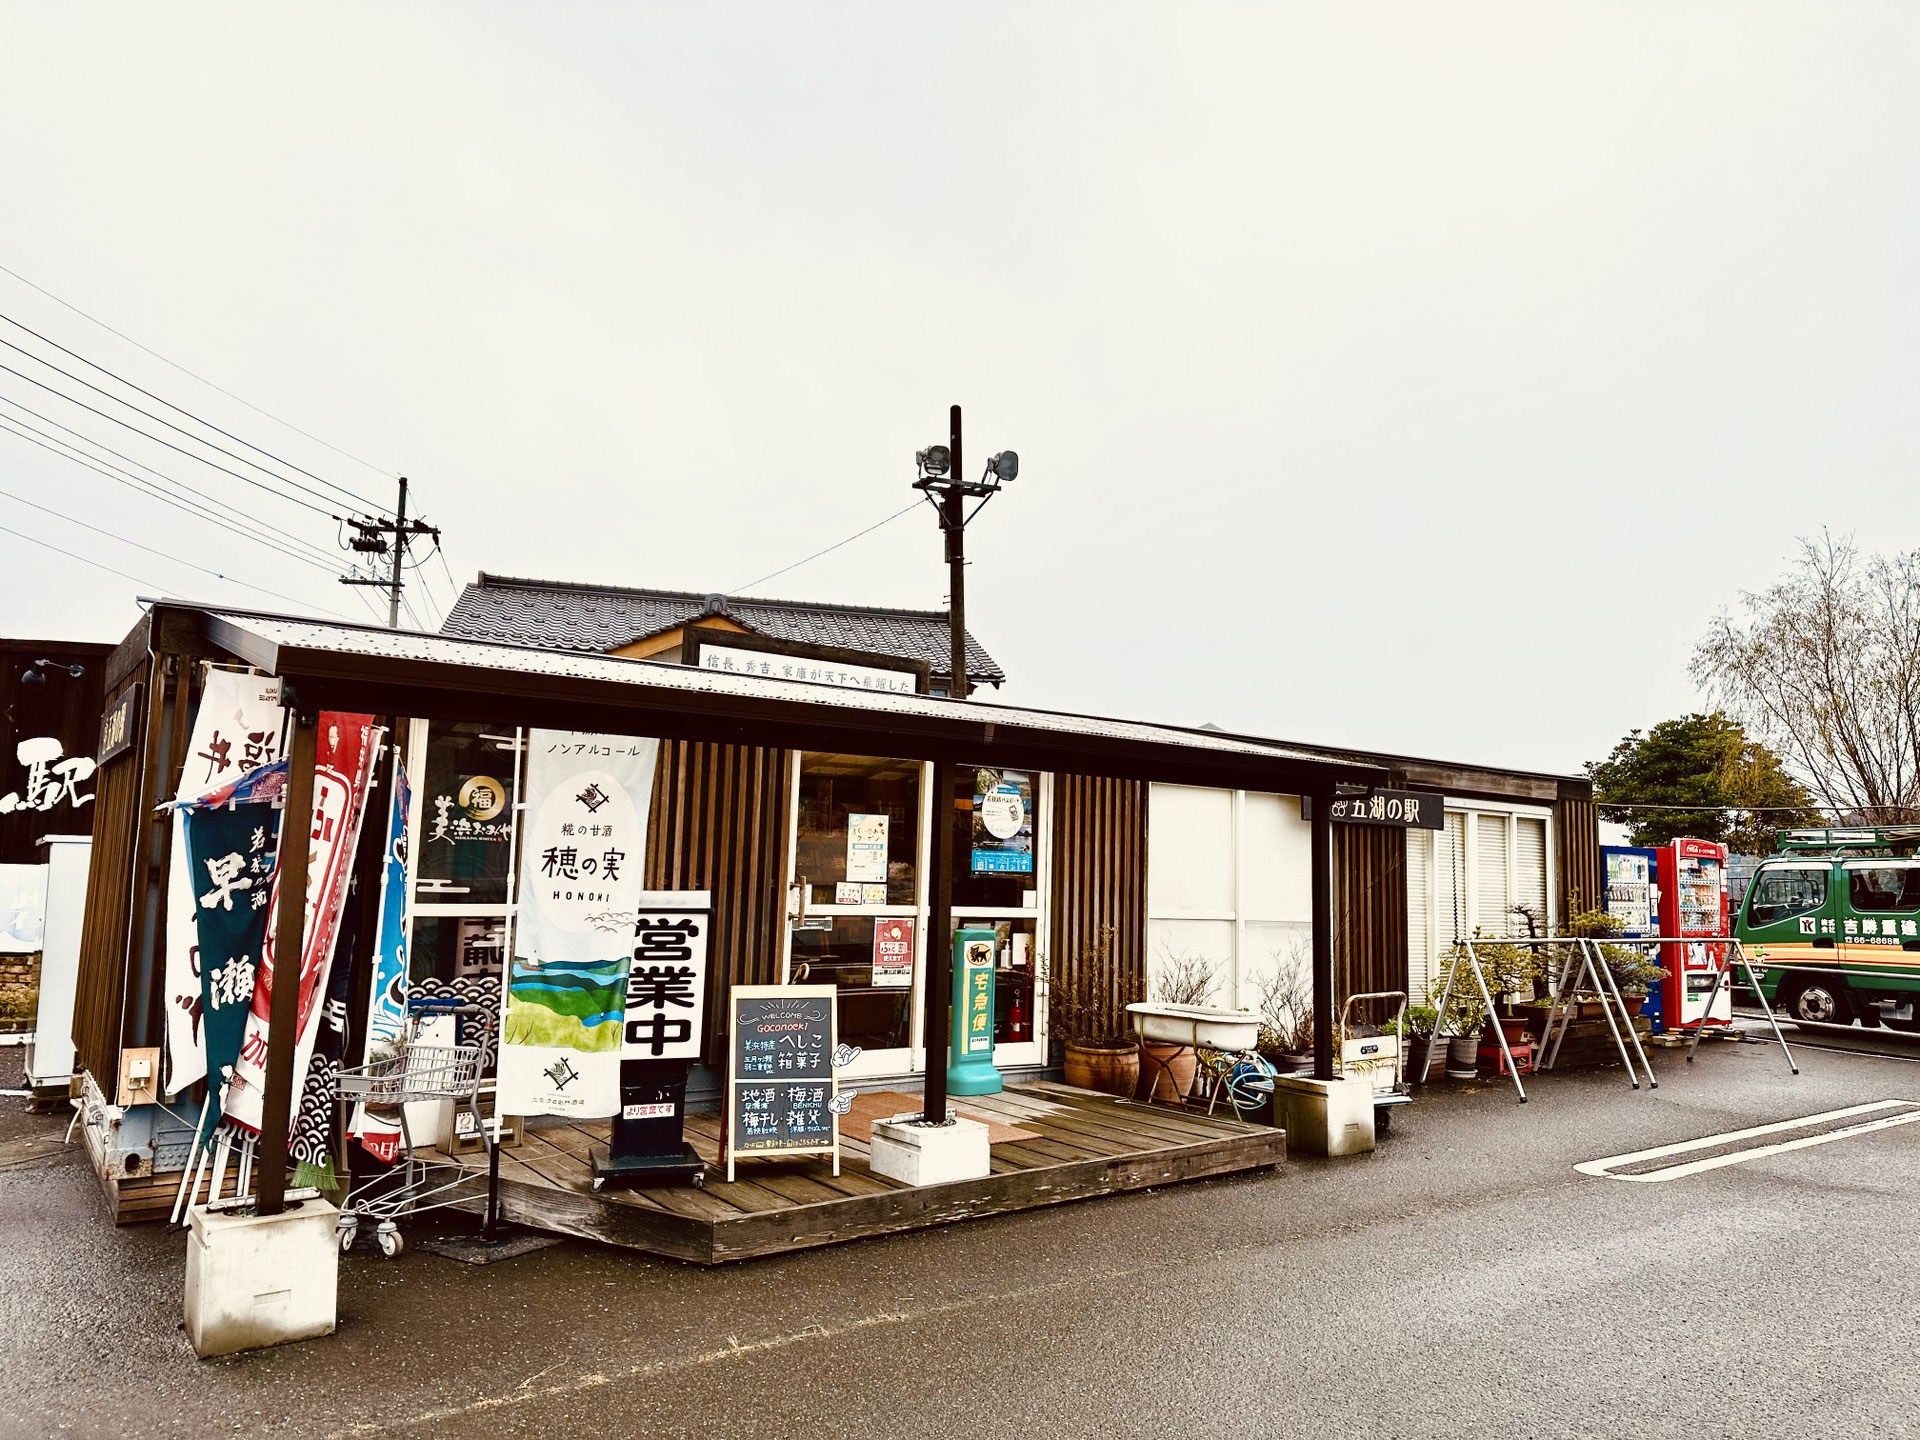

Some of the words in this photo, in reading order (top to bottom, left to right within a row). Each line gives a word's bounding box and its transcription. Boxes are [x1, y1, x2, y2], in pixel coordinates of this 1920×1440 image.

[706, 654, 909, 692] 信長、秀吉、家康が天下へ飛躍した
[547, 743, 641, 757] ノンアルコール
[471, 788, 494, 809] 福
[1350, 795, 1420, 823] 五湖の駅
[560, 822, 613, 838] 糀の甘酒
[541, 846, 626, 882] 穂の実
[625, 918, 699, 1057] 営業中
[972, 972, 990, 1032] 宅急便
[761, 1011, 803, 1021] WELCOME
[779, 1034, 822, 1049] へしこ
[626, 1104, 673, 1116] より営業です
